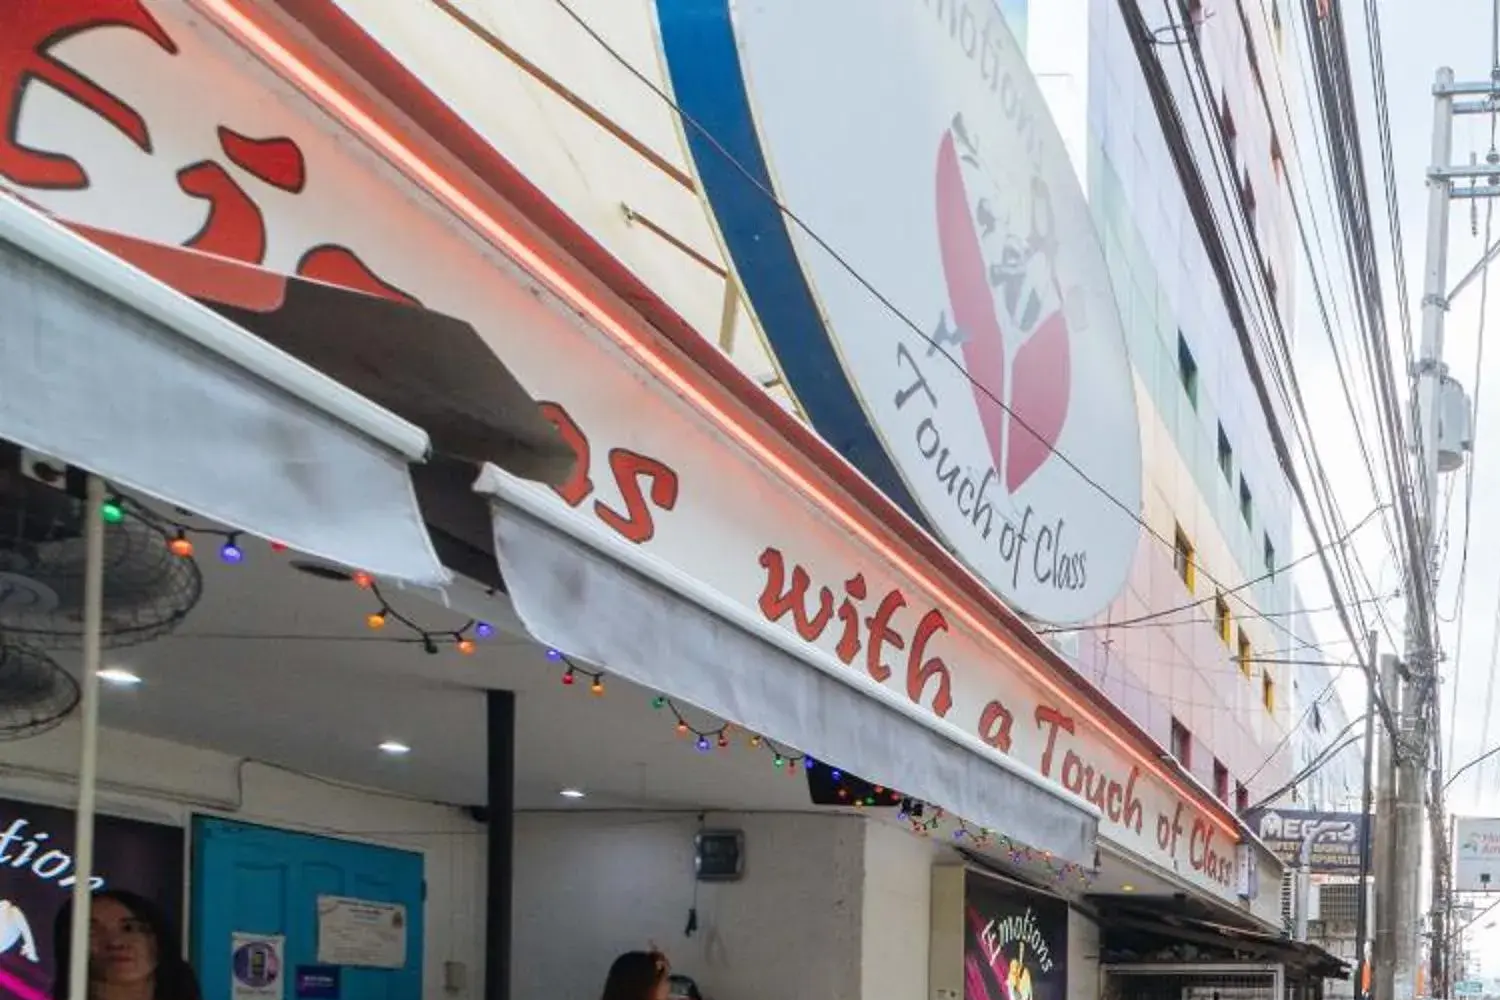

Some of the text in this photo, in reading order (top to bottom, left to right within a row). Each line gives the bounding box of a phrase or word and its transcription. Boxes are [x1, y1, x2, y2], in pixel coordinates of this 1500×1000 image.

[893, 341, 994, 540] Touch
[999, 505, 1034, 590] of
[1033, 518, 1087, 589] Class
[758, 547, 953, 717] with
[978, 700, 1013, 756] a
[1034, 704, 1143, 836] Touch
[1157, 801, 1183, 858] of
[981, 907, 1053, 973] Emotions
